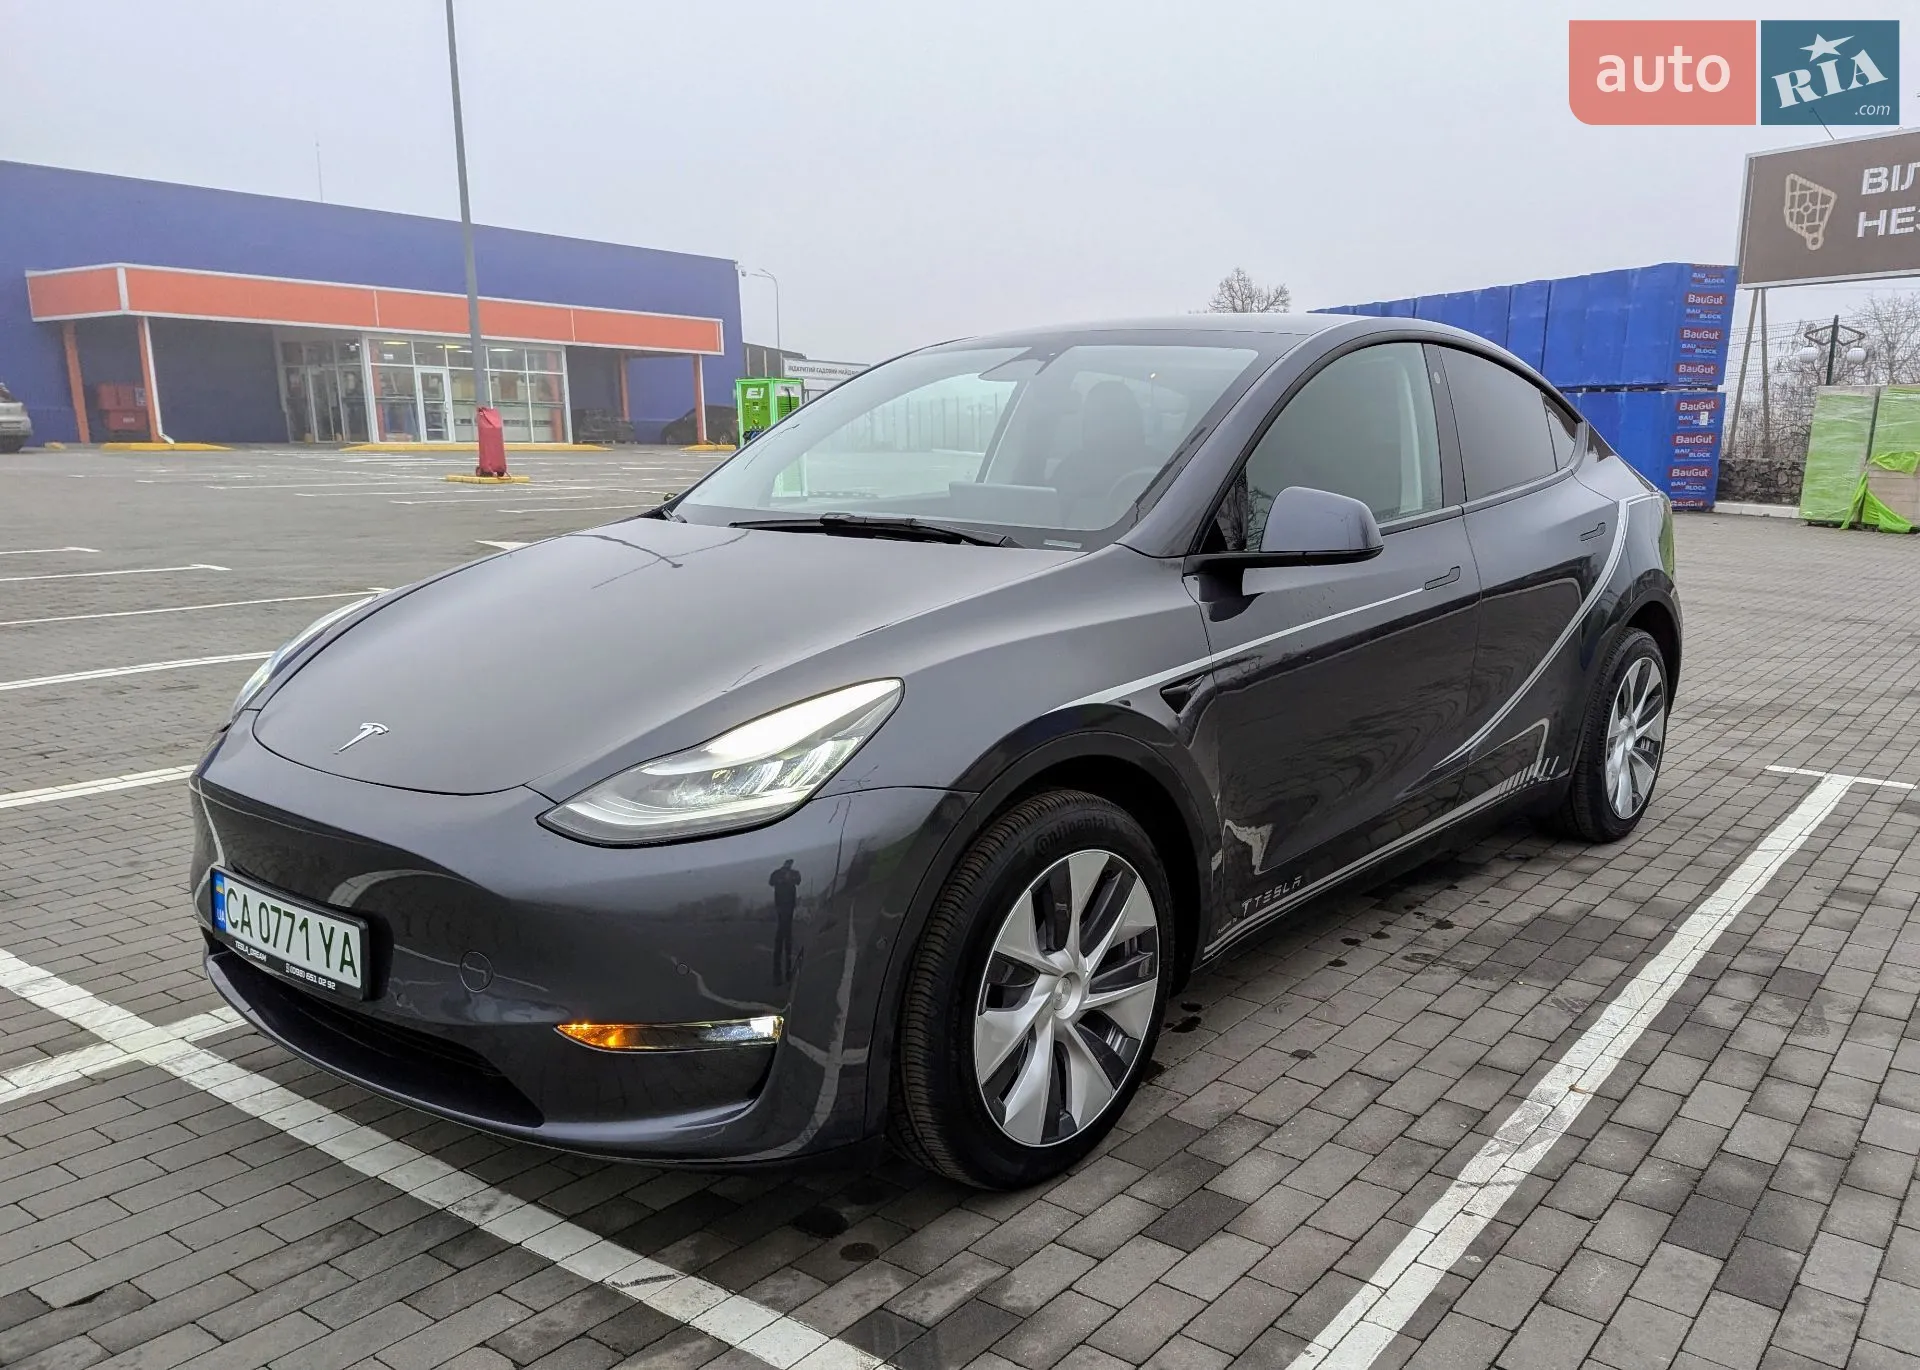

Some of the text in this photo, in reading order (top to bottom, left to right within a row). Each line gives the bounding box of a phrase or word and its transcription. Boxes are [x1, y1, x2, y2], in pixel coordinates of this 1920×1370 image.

[1688, 294, 1723, 305] BauGut
[1683, 329, 1719, 340] BauGut
[1679, 364, 1714, 375] BauGut
[1679, 400, 1715, 411] BauGut
[1676, 434, 1712, 444] BauGut
[1671, 468, 1708, 477] BauGut
[216, 908, 226, 923] UA
[226, 887, 358, 978] CA 0771 YA
